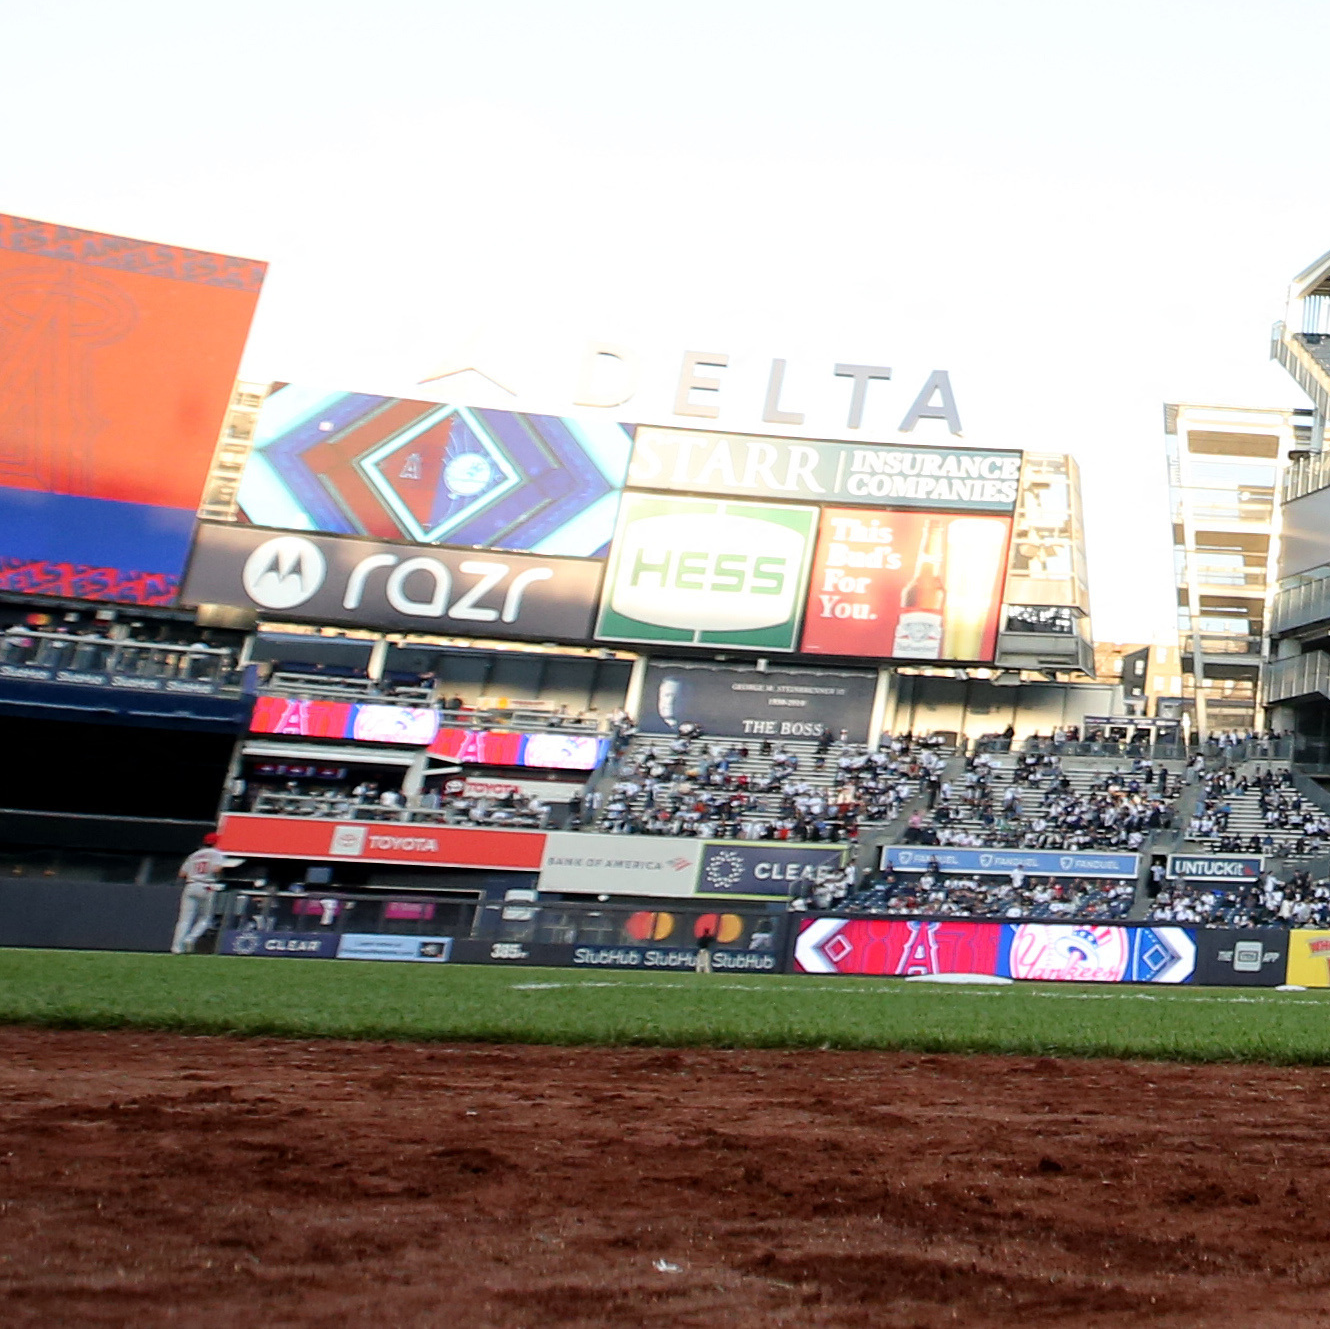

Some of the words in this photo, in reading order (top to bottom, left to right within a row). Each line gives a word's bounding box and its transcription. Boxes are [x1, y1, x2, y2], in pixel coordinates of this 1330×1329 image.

[572, 338, 966, 438] DELTA
[628, 431, 827, 495] STARR
[851, 449, 1021, 480] INSURANCE
[846, 473, 1018, 503] COMPANIES
[831, 517, 893, 544] This
[827, 543, 903, 570] Bud's
[628, 547, 788, 596] HESS
[823, 569, 872, 594] For
[342, 552, 554, 625] razr
[818, 595, 878, 620] You.
[742, 719, 776, 735] THE
[780, 720, 826, 737] BOSS
[368, 834, 439, 853] TOYOTA
[548, 856, 583, 869] BANK
[586, 857, 604, 869] OF
[604, 857, 664, 871] AMERICA
[1175, 860, 1244, 877] UNTUCKit
[263, 938, 321, 953] CLEAR
[573, 948, 641, 966] StubHub
[643, 950, 701, 969] StubHu
[711, 952, 774, 971] StubHub
